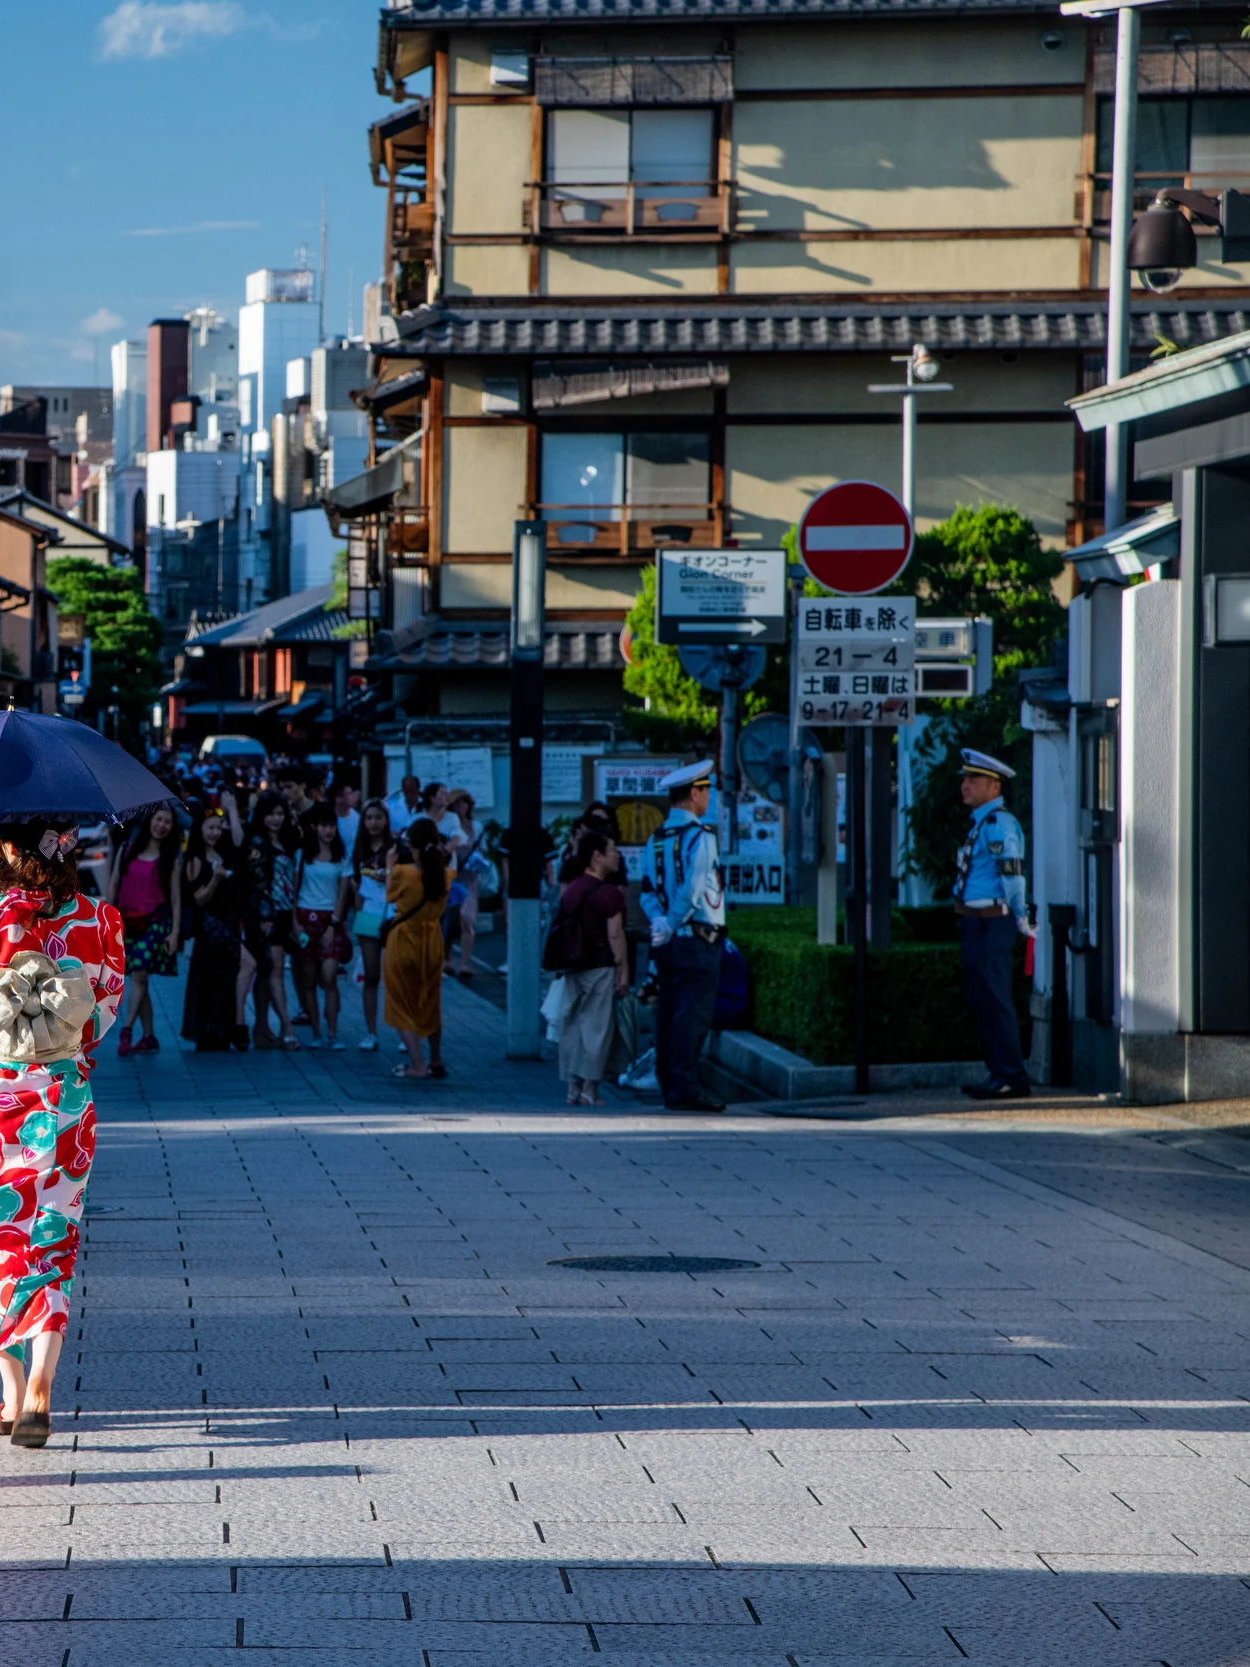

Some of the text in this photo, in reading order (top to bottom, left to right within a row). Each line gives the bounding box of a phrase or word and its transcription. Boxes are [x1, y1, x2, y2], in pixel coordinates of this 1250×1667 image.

[680, 556, 767, 567] ギオンコーナー
[679, 568, 754, 579] Gion Corner
[805, 607, 909, 631] 自転車を除く
[803, 676, 908, 694] 土曜、日曜は
